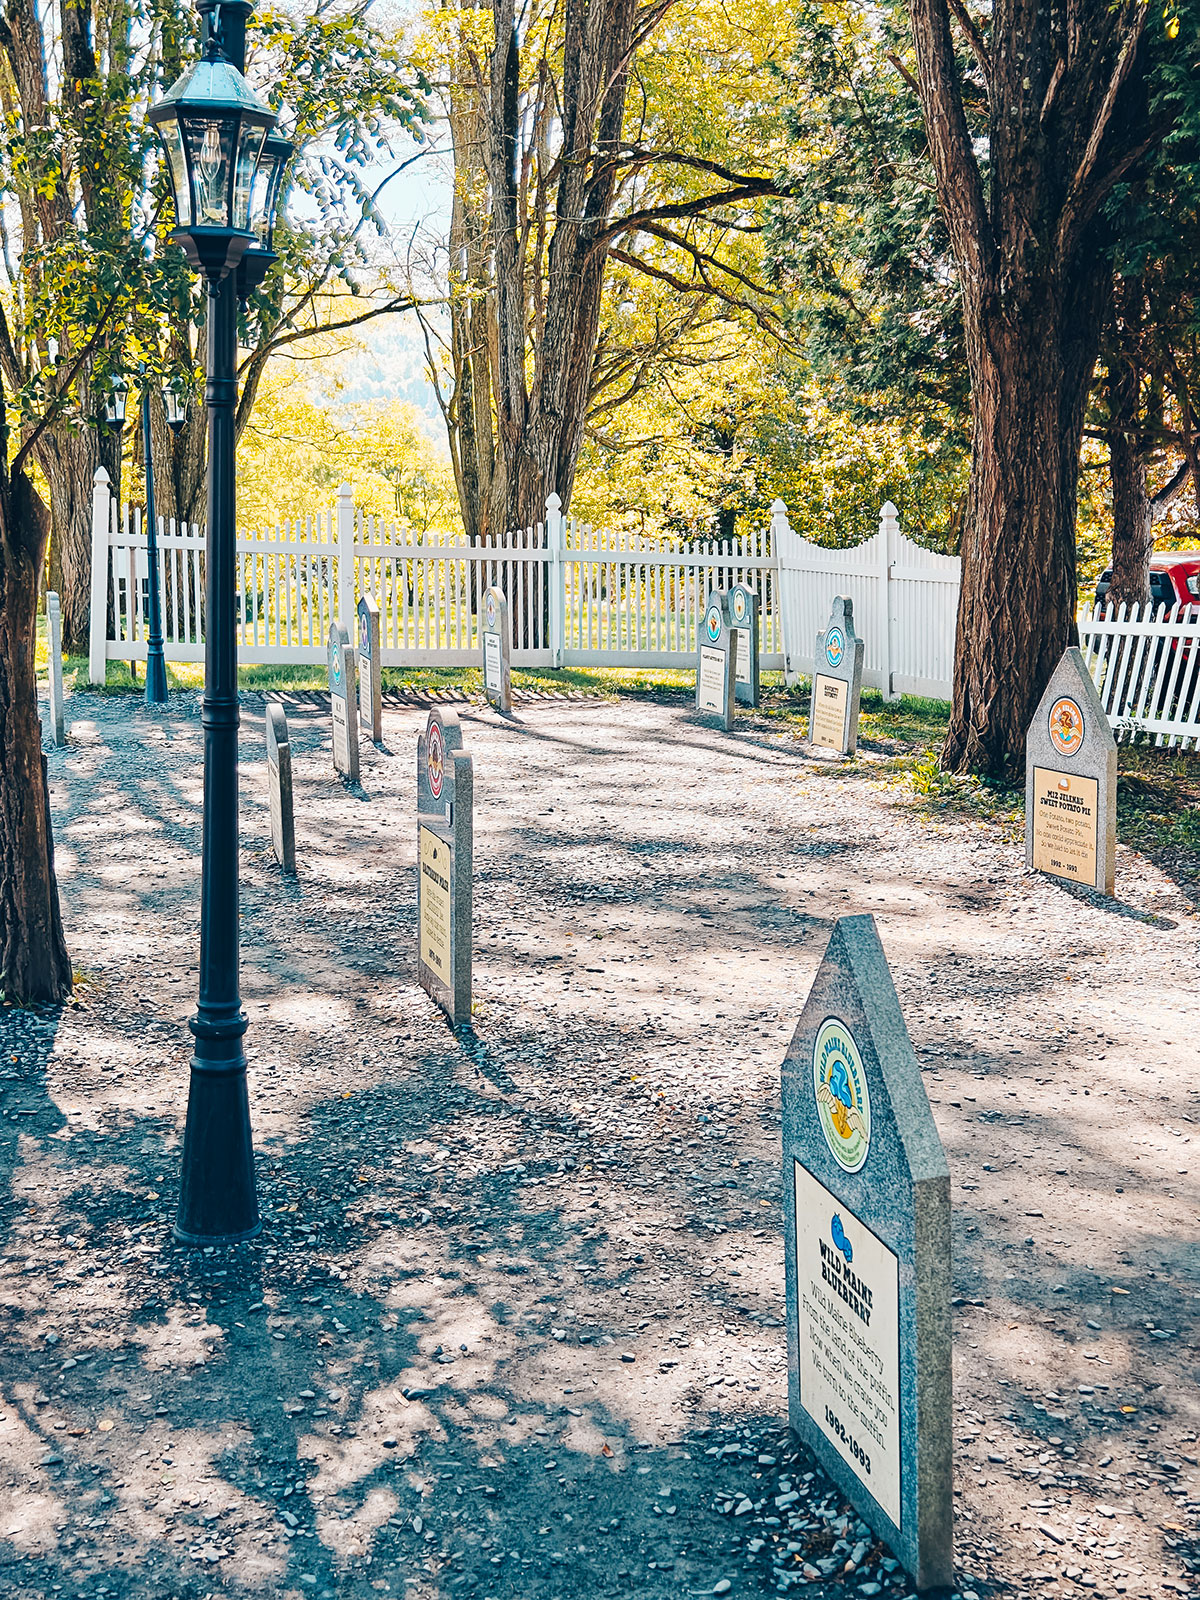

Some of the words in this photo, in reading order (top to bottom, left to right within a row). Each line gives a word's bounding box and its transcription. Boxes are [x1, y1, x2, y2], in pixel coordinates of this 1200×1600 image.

[1040, 797, 1057, 807] SWEET
[1059, 801, 1080, 813] POTATO
[1081, 806, 1090, 815] PIE
[1047, 789, 1057, 799] MIZ
[819, 1237, 841, 1276] WILD
[843, 1262, 872, 1309] MAINE
[821, 1261, 870, 1329] BLUEBERRY
[802, 1292, 818, 1325] From
[819, 1311, 829, 1338] the
[831, 1325, 846, 1357] land
[848, 1344, 855, 1368] of
[856, 1354, 868, 1382] the
[811, 1279, 825, 1310] Wild
[827, 1298, 847, 1335] Maine
[849, 1321, 883, 1376] Blueberry
[809, 1323, 822, 1352] Now
[824, 1341, 842, 1376] when
[843, 1365, 852, 1387] we
[854, 1377, 872, 1411] crave
[874, 1401, 887, 1431] you
[812, 1348, 821, 1374] We
[823, 1363, 837, 1392] turn
[838, 1381, 845, 1403] to
[847, 1391, 858, 1418] the
[860, 1407, 885, 1452] muffin.
[825, 1403, 871, 1476] 1992-1993
